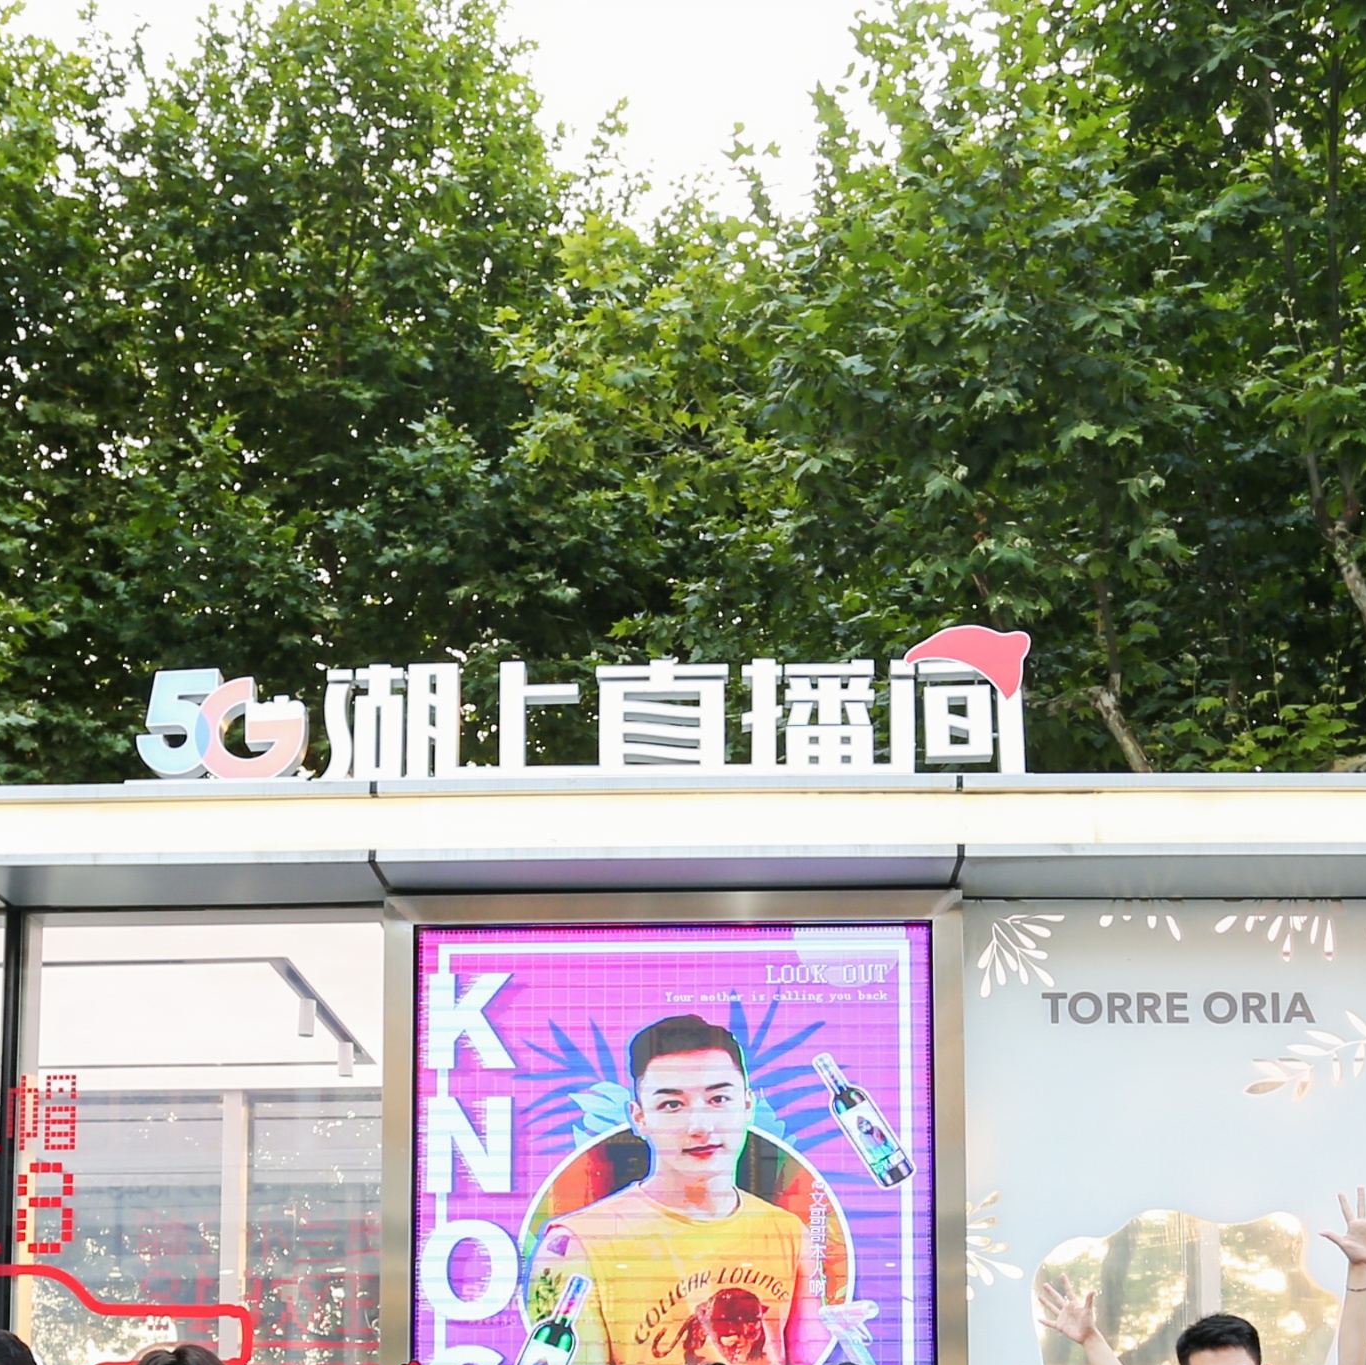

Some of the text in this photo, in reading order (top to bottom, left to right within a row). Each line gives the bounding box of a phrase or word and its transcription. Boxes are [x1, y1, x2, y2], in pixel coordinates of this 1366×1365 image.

[765, 964, 888, 984] LOOK OUT
[665, 990, 888, 1003] Your mother is calling you back
[1041, 991, 1315, 1025] TORRE ORIA
